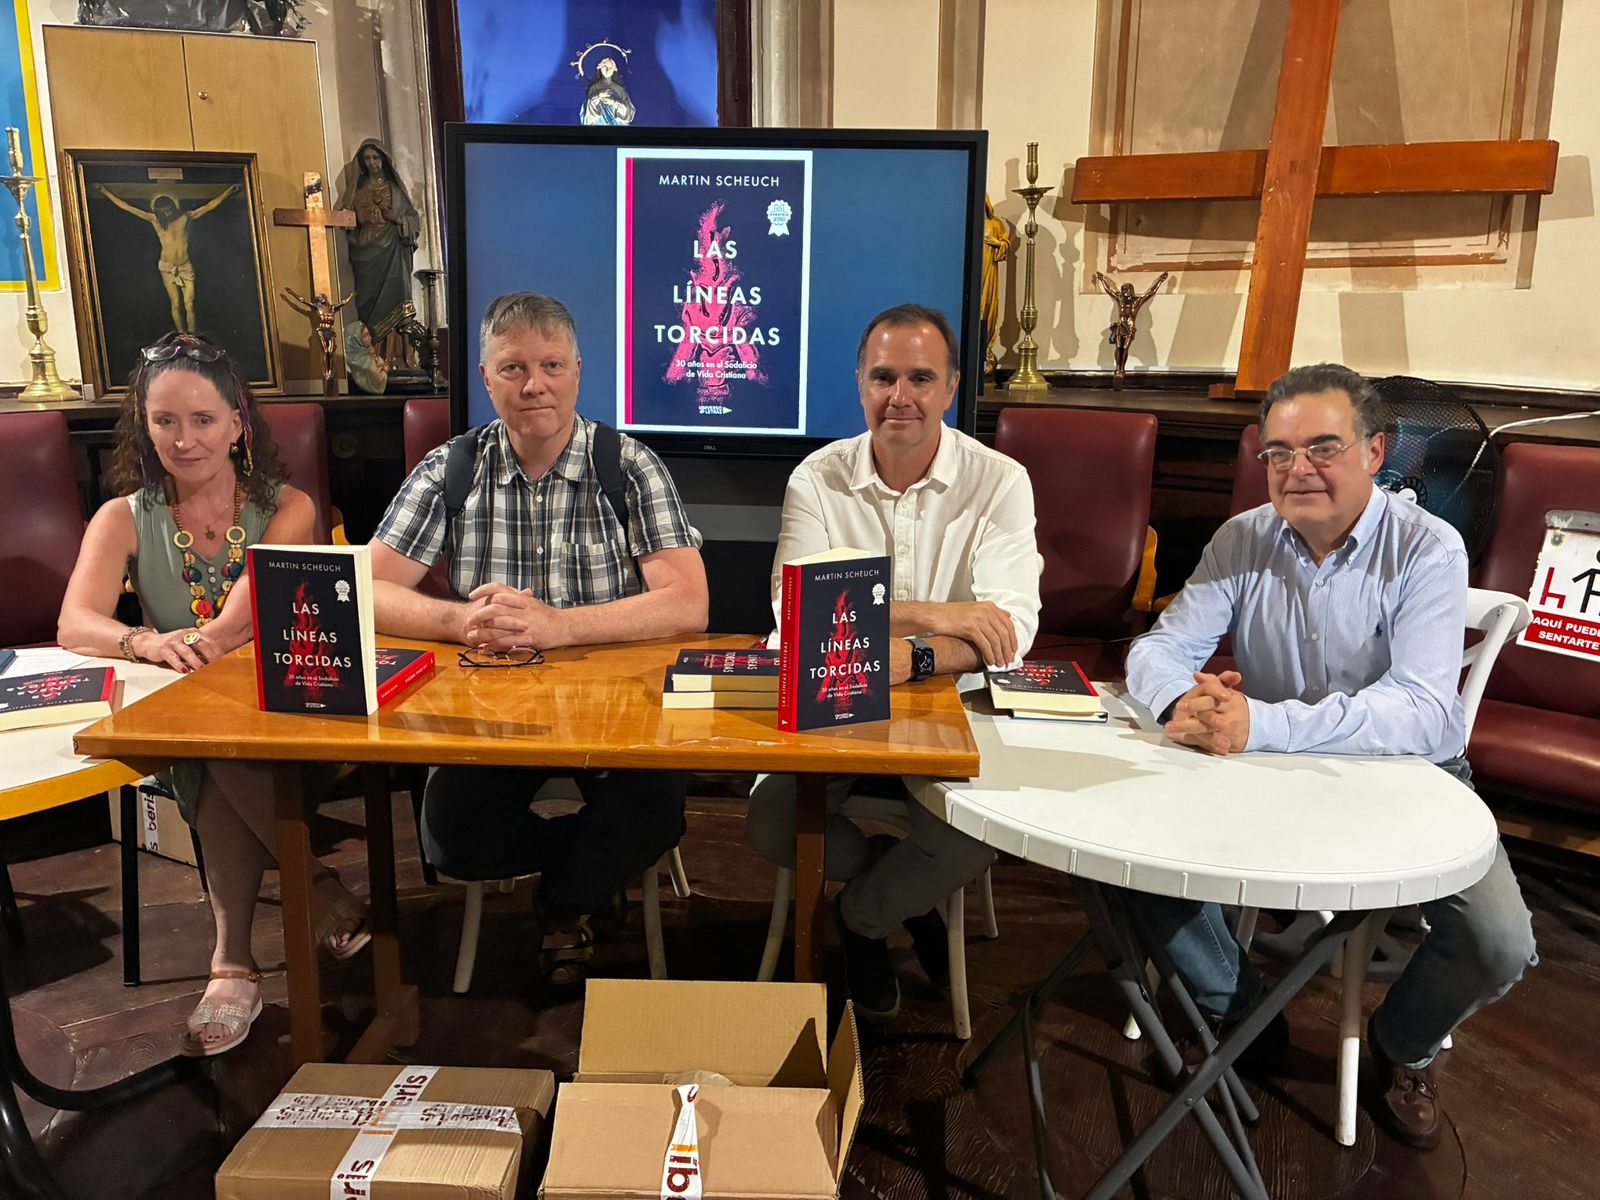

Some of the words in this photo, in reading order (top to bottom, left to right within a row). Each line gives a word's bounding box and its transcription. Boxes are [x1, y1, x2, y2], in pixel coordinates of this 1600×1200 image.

[659, 174, 711, 187] MARTIN
[716, 175, 780, 187] SCHEUCH
[693, 240, 738, 259] LAS
[673, 280, 762, 306] LÍNEAS
[654, 324, 781, 346] TORCIDAS
[687, 360, 704, 368] años
[716, 360, 723, 368] el
[724, 360, 757, 369] Sodalicio
[686, 370, 695, 378] de
[697, 370, 714, 378] Vida
[715, 370, 746, 379] Cristiana
[268, 561, 299, 570] MARTIN
[301, 563, 341, 572] SCHEUCH
[815, 572, 843, 582] MARTIN
[845, 569, 880, 579] SCHEUCH
[292, 602, 320, 615] LAS
[832, 610, 857, 625] LAS
[1532, 616, 1562, 629] AQUÍ
[282, 626, 338, 643] LÍNEAS
[1538, 631, 1600, 650] SENTARTE
[820, 637, 870, 654] LÍNEAS
[273, 652, 352, 668] TORCIDAS
[810, 660, 881, 680] TORCIDAS
